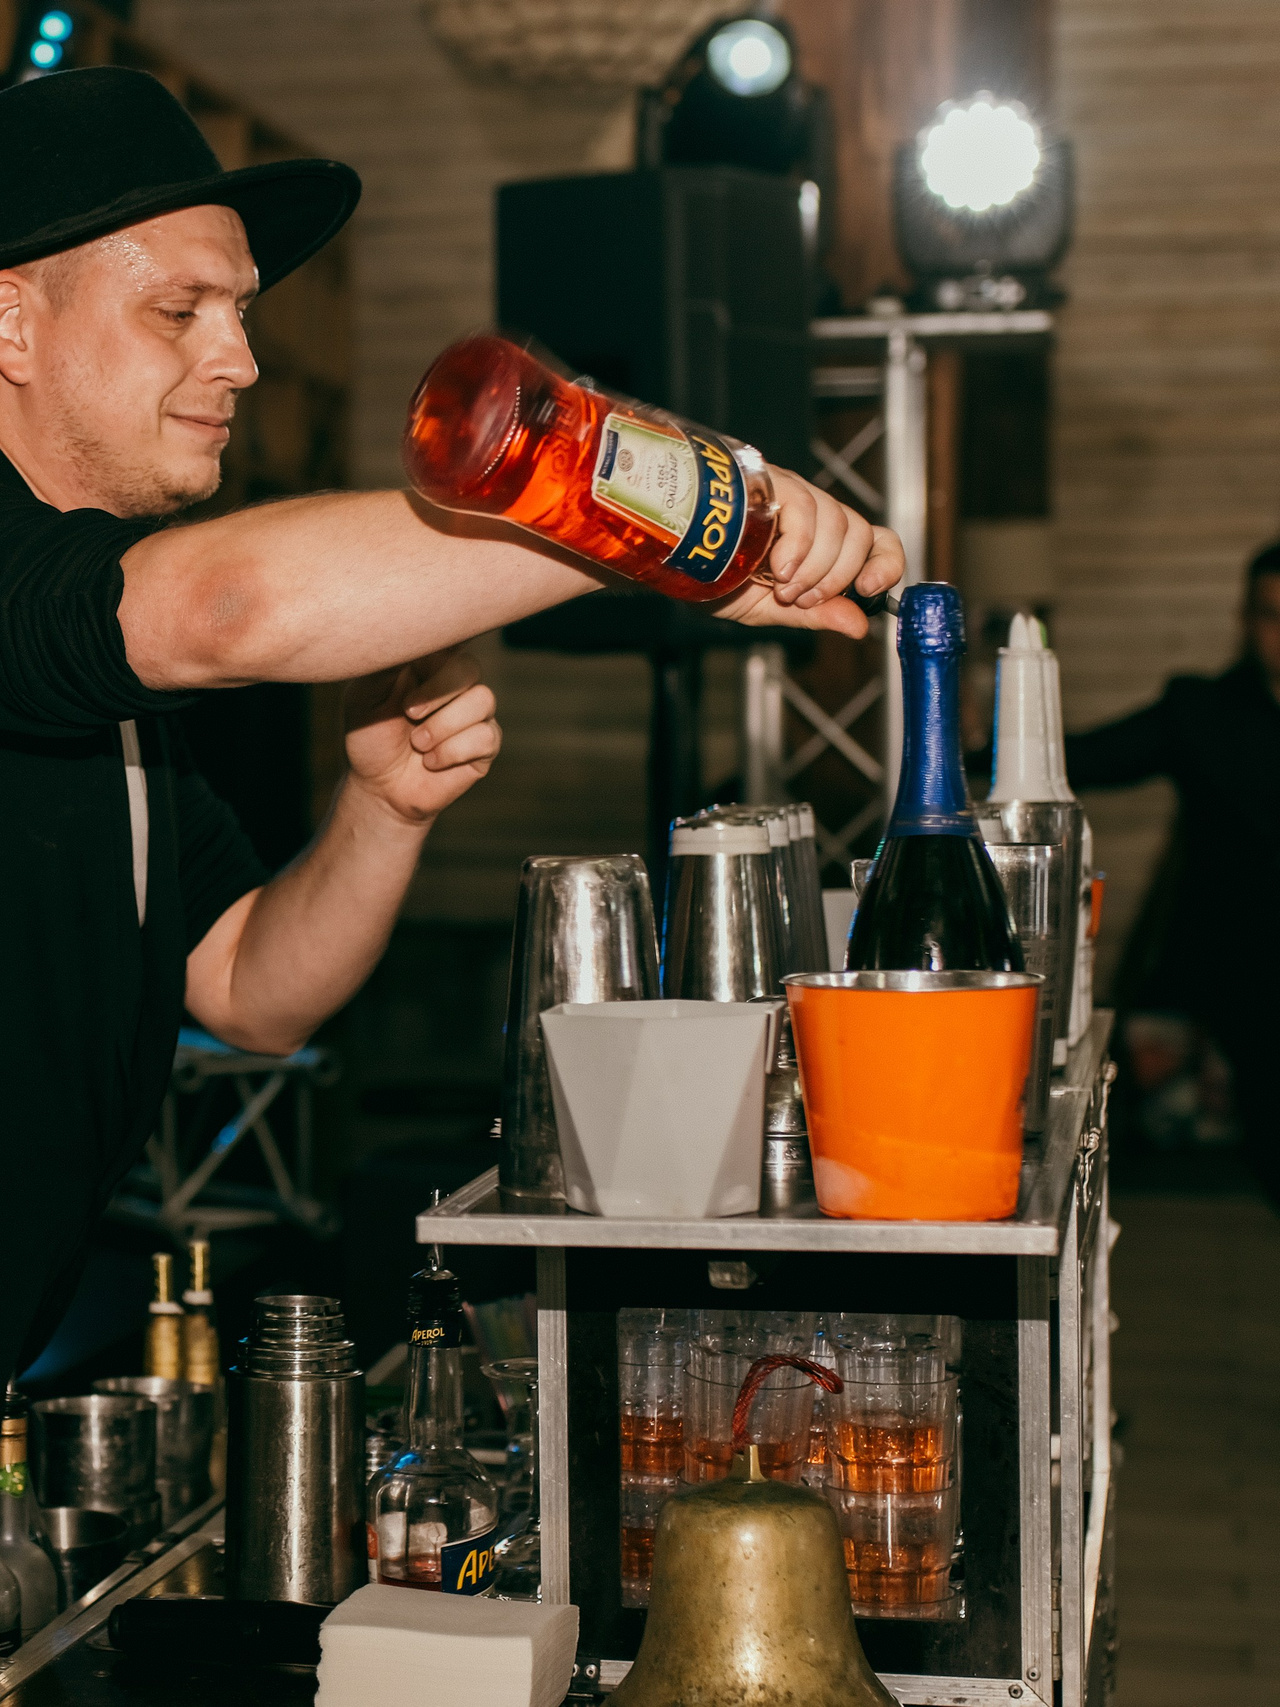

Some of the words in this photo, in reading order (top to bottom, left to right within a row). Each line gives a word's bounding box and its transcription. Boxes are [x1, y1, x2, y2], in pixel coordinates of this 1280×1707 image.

[665, 452, 679, 509] APERITIVO
[687, 435, 733, 561] APEROL
[410, 1327, 446, 1343] APEROL
